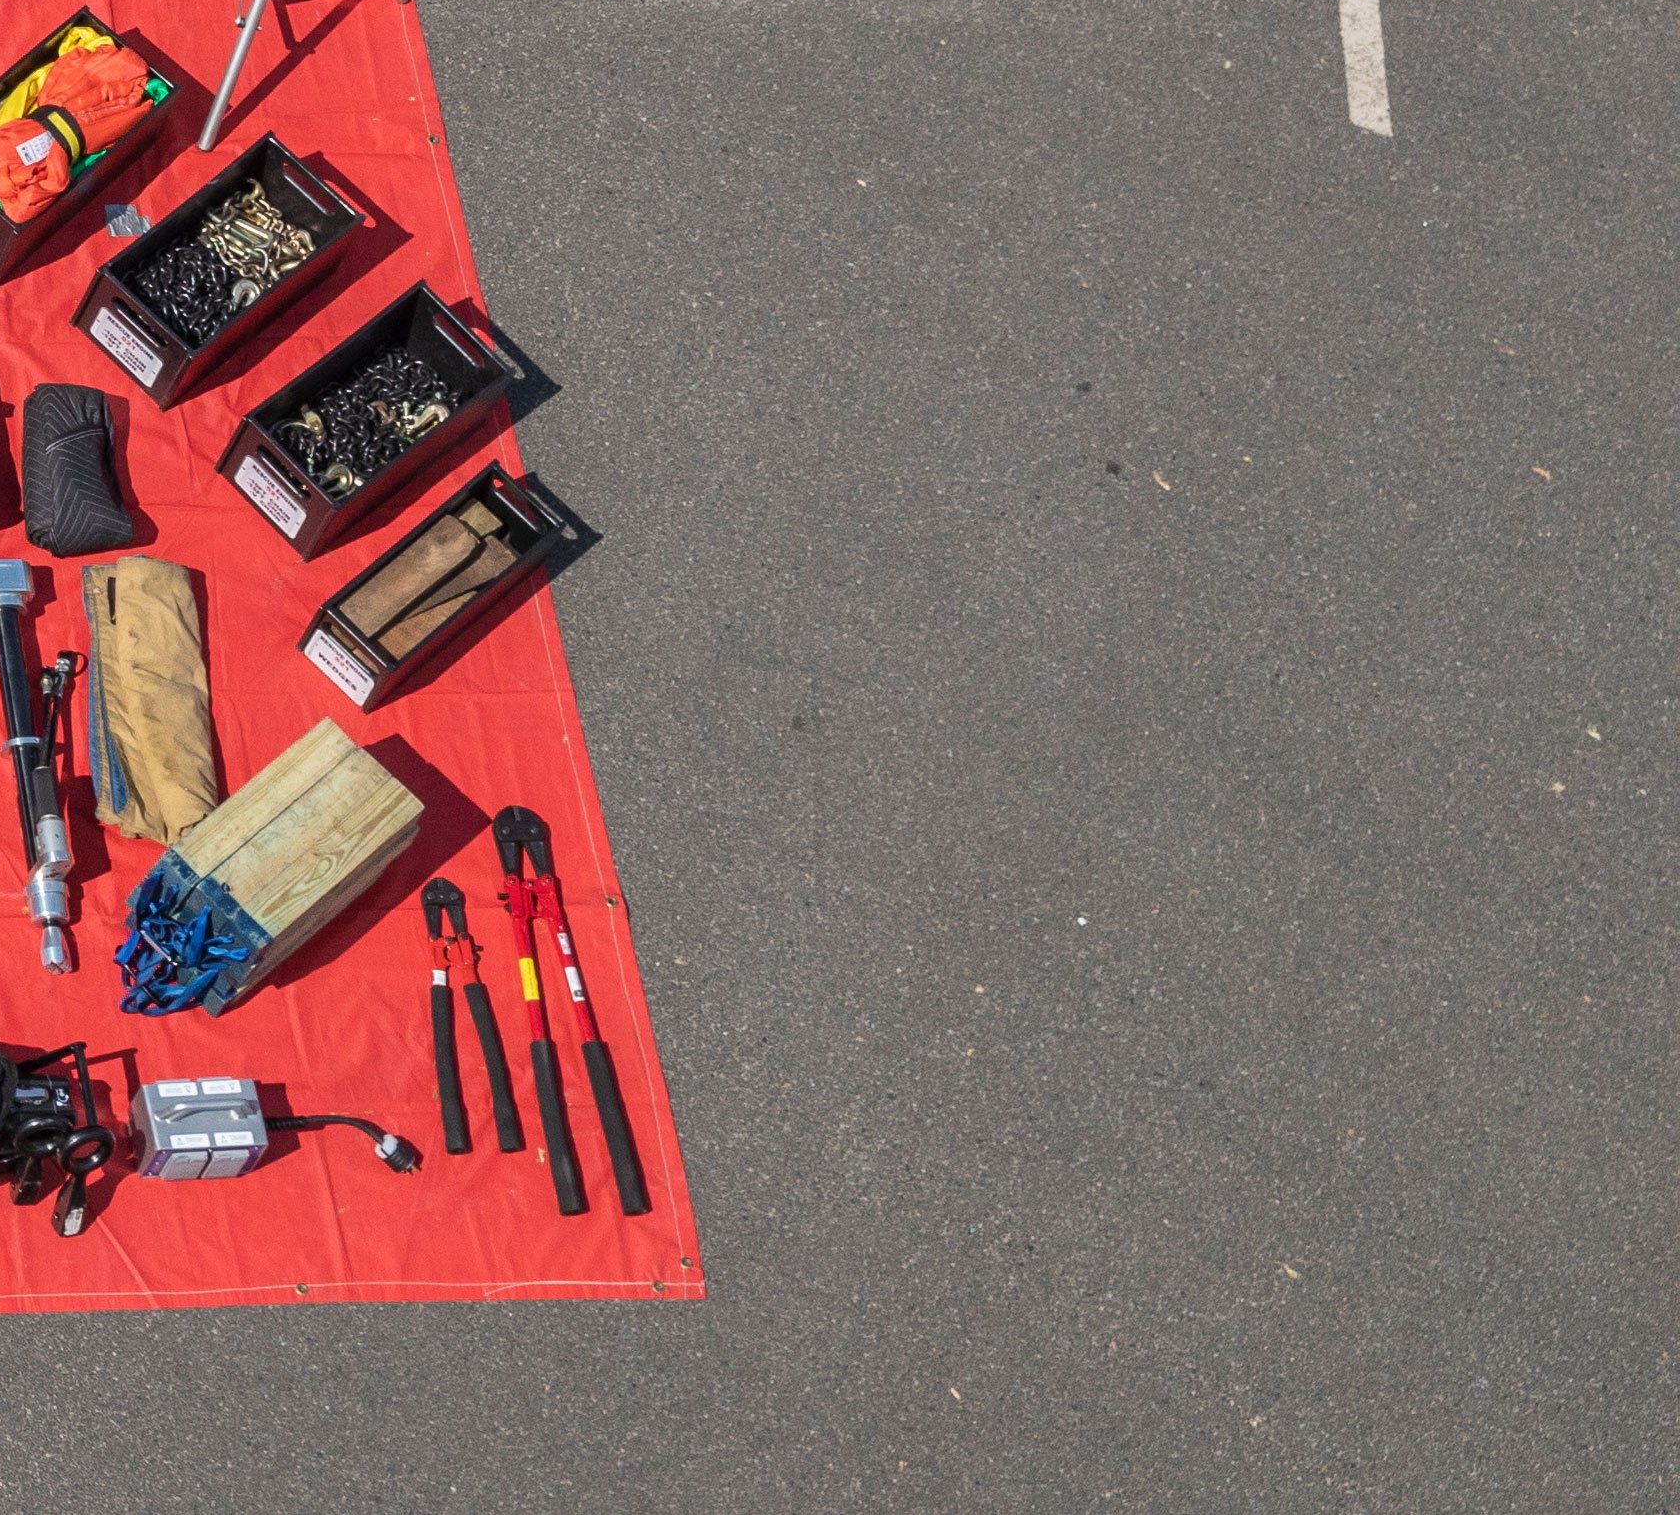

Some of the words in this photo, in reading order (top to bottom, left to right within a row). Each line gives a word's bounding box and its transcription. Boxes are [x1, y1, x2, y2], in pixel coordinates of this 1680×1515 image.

[107, 316, 133, 339] RESCUE
[130, 336, 154, 361] ENGINE
[252, 464, 278, 489] RESCUE
[275, 486, 298, 513] ENGINE
[318, 652, 358, 692] WEDGES
[319, 635, 346, 659] RESCUE
[343, 657, 369, 683] ENGINE
